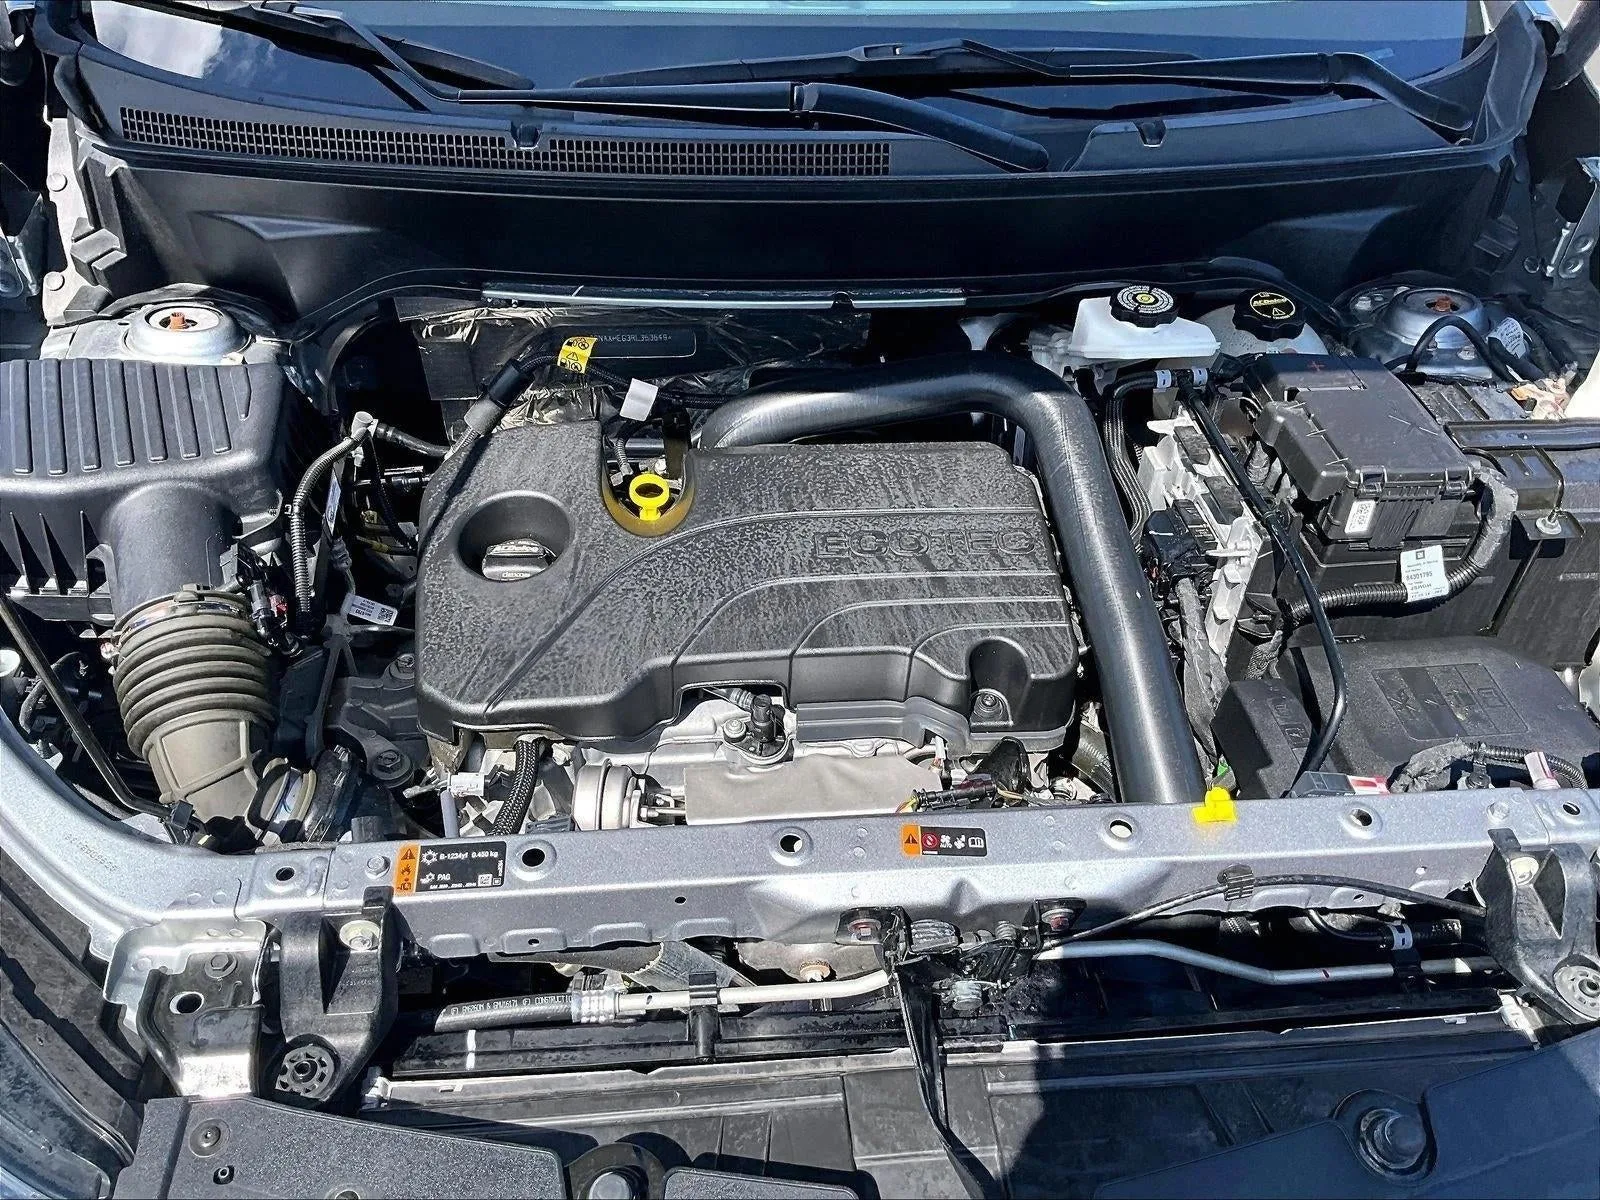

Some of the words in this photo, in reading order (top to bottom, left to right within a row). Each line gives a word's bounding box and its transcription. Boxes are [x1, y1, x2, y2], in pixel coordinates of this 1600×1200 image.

[813, 529, 1036, 558] ECOTEC
[490, 850, 499, 859] kg
[436, 873, 451, 881] PAG
